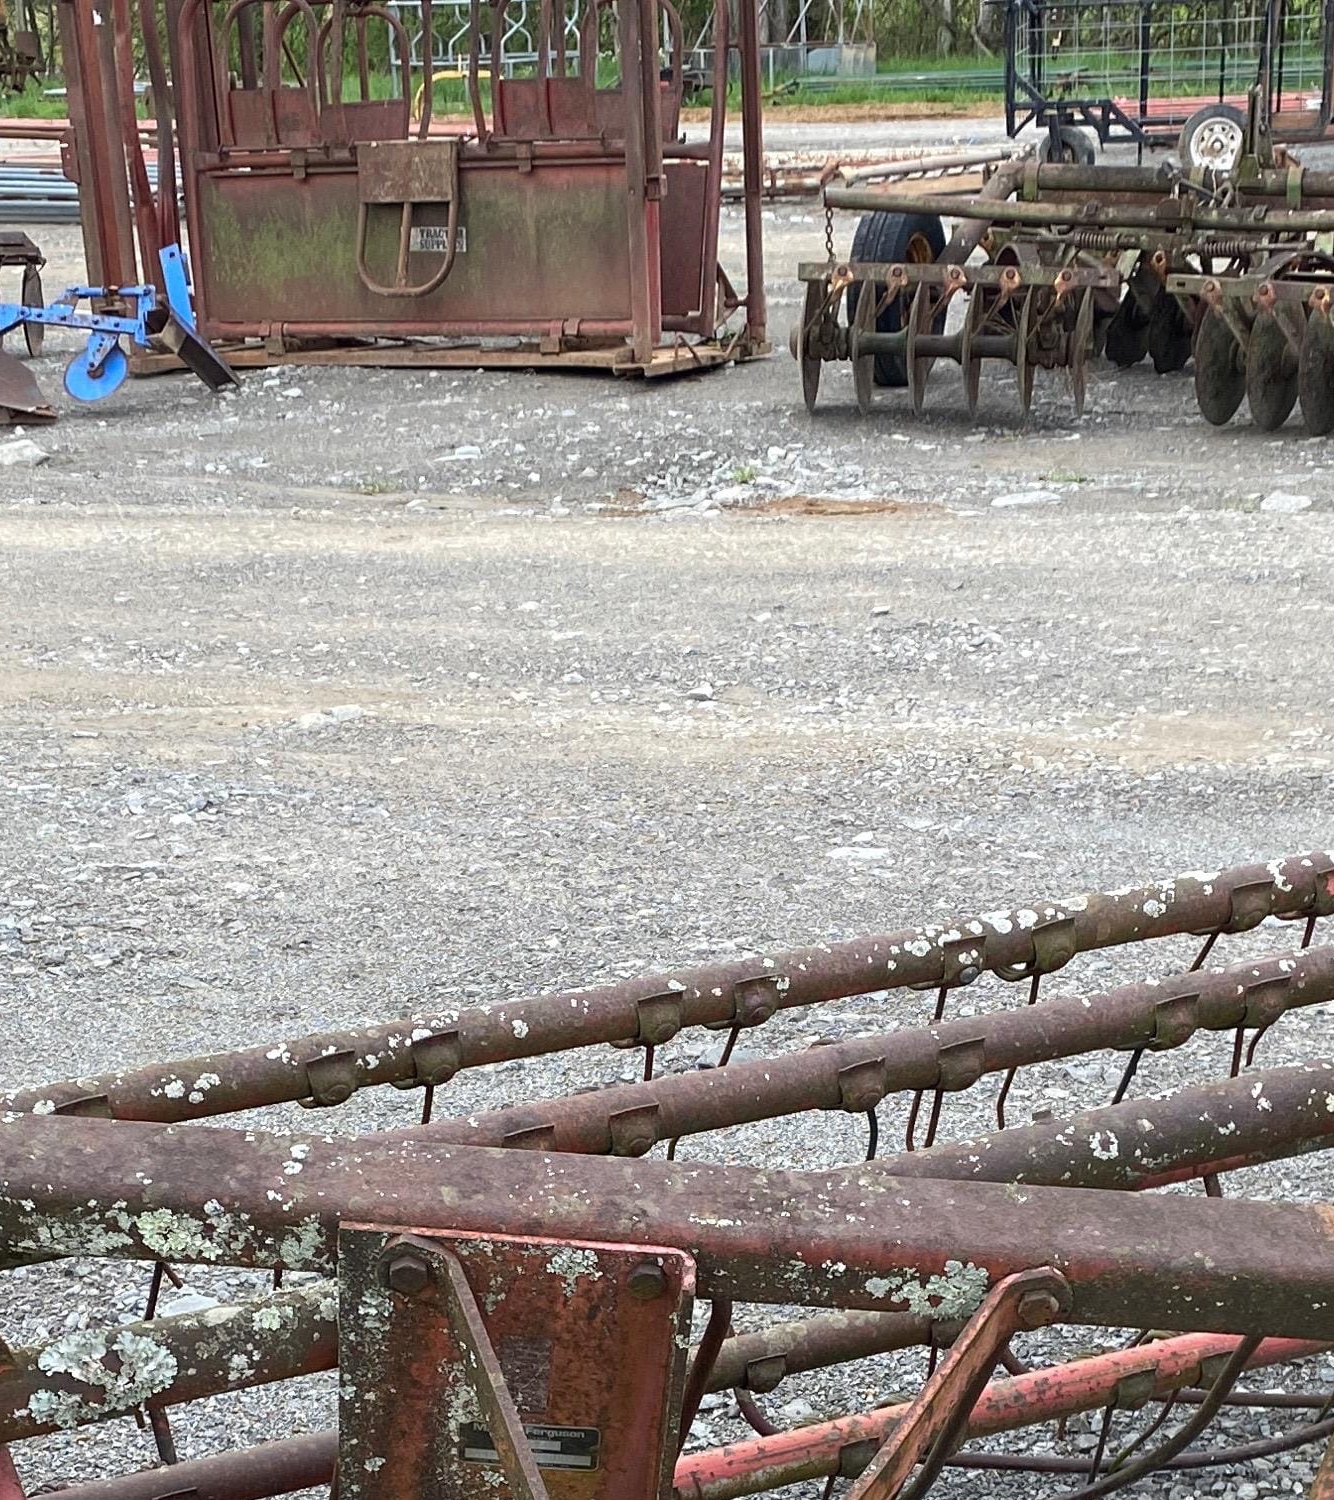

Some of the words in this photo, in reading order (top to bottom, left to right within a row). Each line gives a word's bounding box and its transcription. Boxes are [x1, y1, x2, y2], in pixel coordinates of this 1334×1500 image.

[419, 229, 464, 239] TRACTR
[419, 239, 454, 250] SUPPL
[525, 1427, 585, 1439] Ferguson
